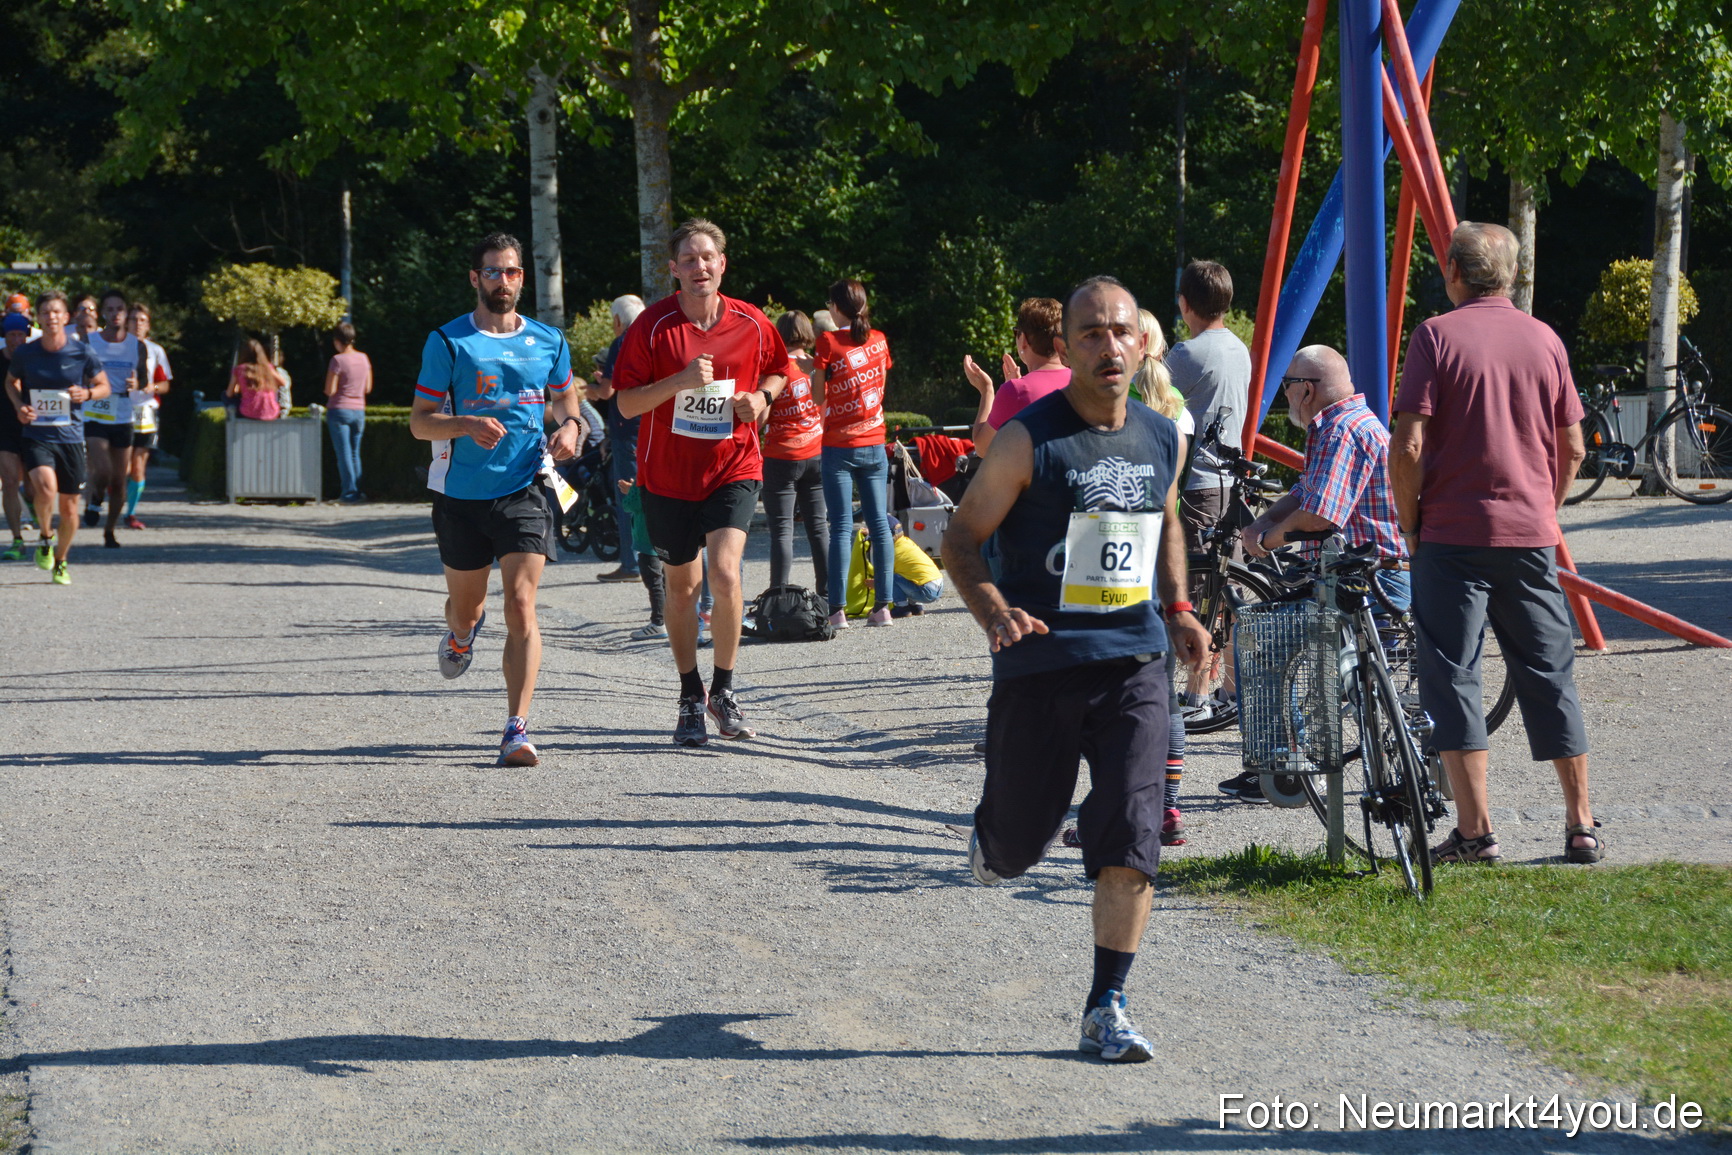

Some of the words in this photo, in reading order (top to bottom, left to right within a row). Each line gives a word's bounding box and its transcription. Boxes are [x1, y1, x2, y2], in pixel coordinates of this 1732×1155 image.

[831, 366, 881, 393] aumbox
[37, 400, 63, 410] 2121
[683, 396, 727, 414] 2467
[689, 423, 718, 432] Markus
[1066, 464, 1112, 487] Pacific
[1099, 522, 1138, 533] BOCK
[1100, 541, 1133, 572] 62
[1086, 575, 1108, 583] PARTL
[1101, 590, 1128, 606] Eyup
